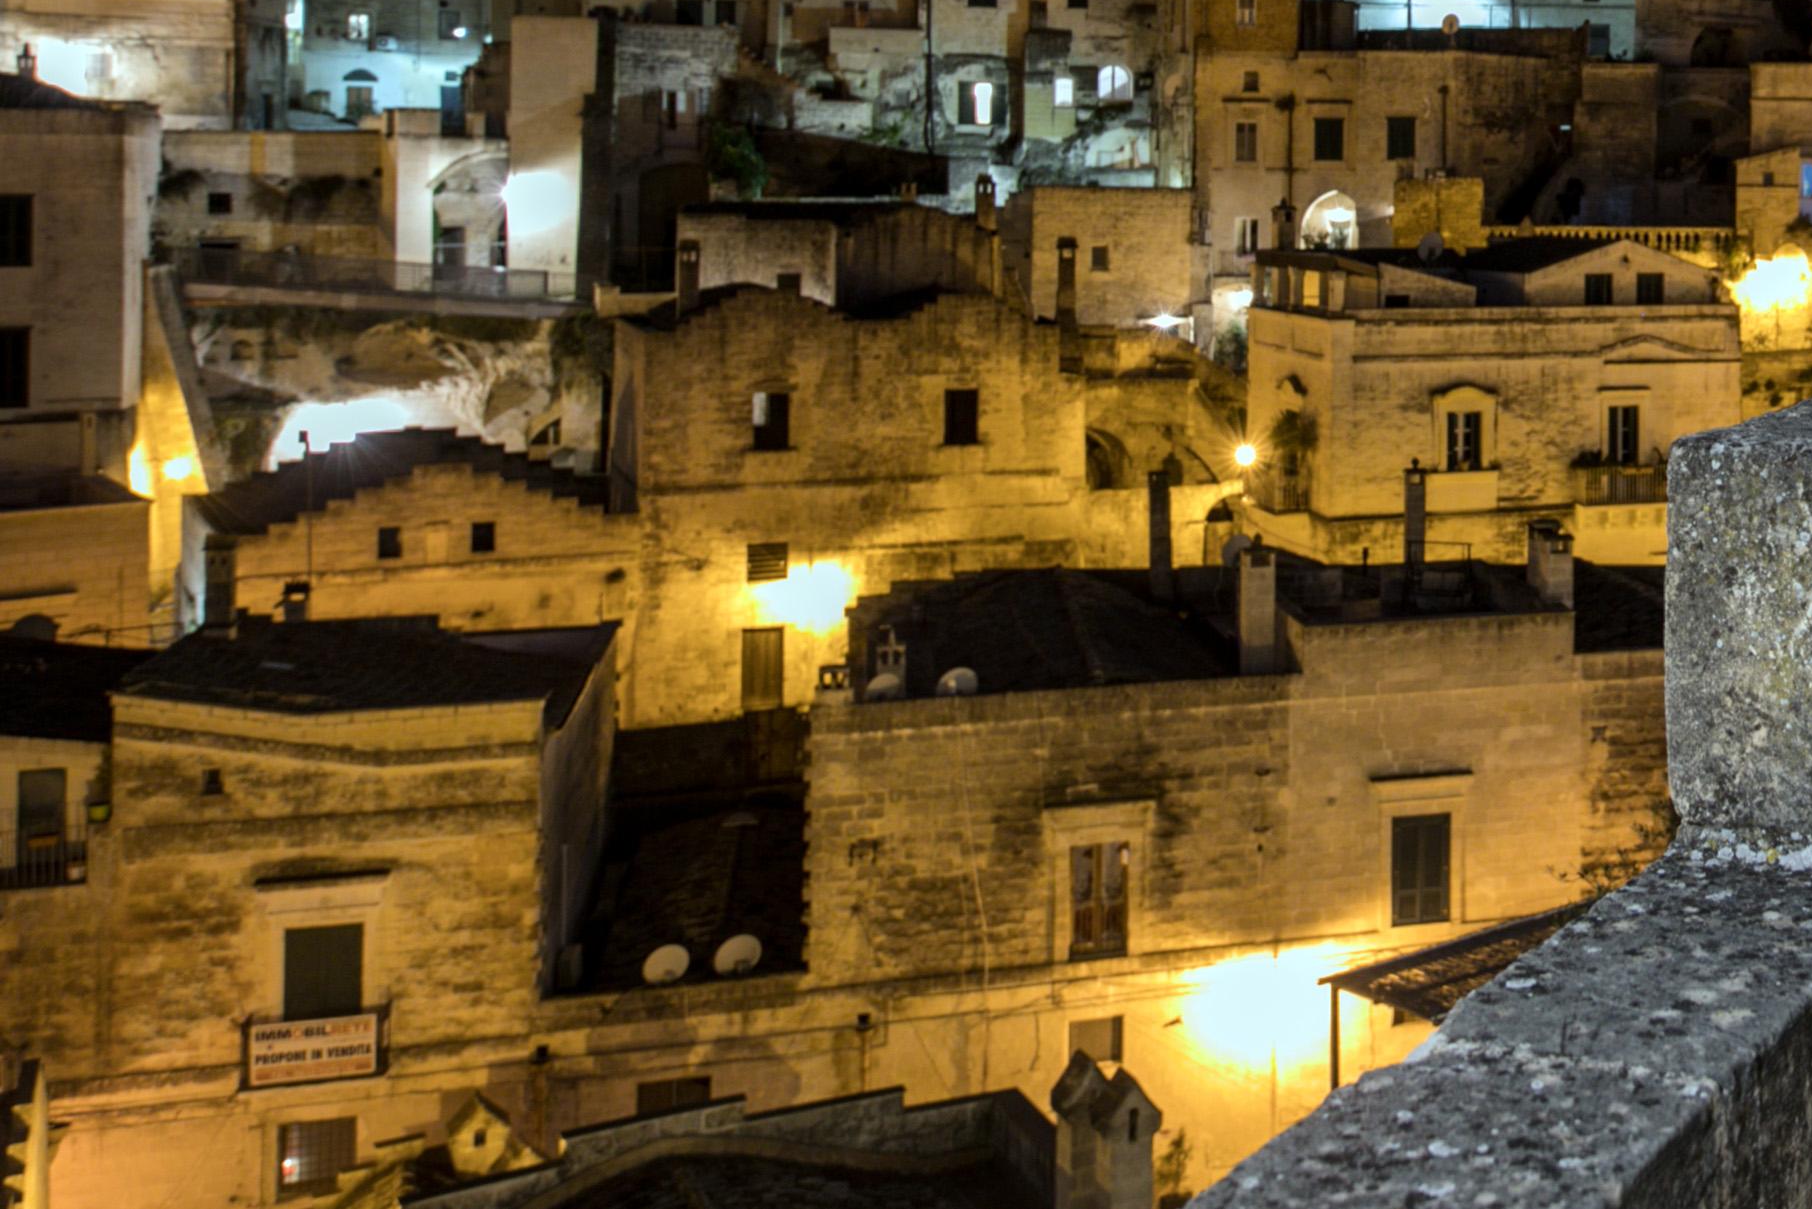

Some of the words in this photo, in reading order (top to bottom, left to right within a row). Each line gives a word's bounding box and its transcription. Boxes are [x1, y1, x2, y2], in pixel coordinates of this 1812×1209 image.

[255, 1050, 306, 1065] PROPONE
[311, 1047, 323, 1060] IN
[328, 1043, 371, 1058] VENDITA
